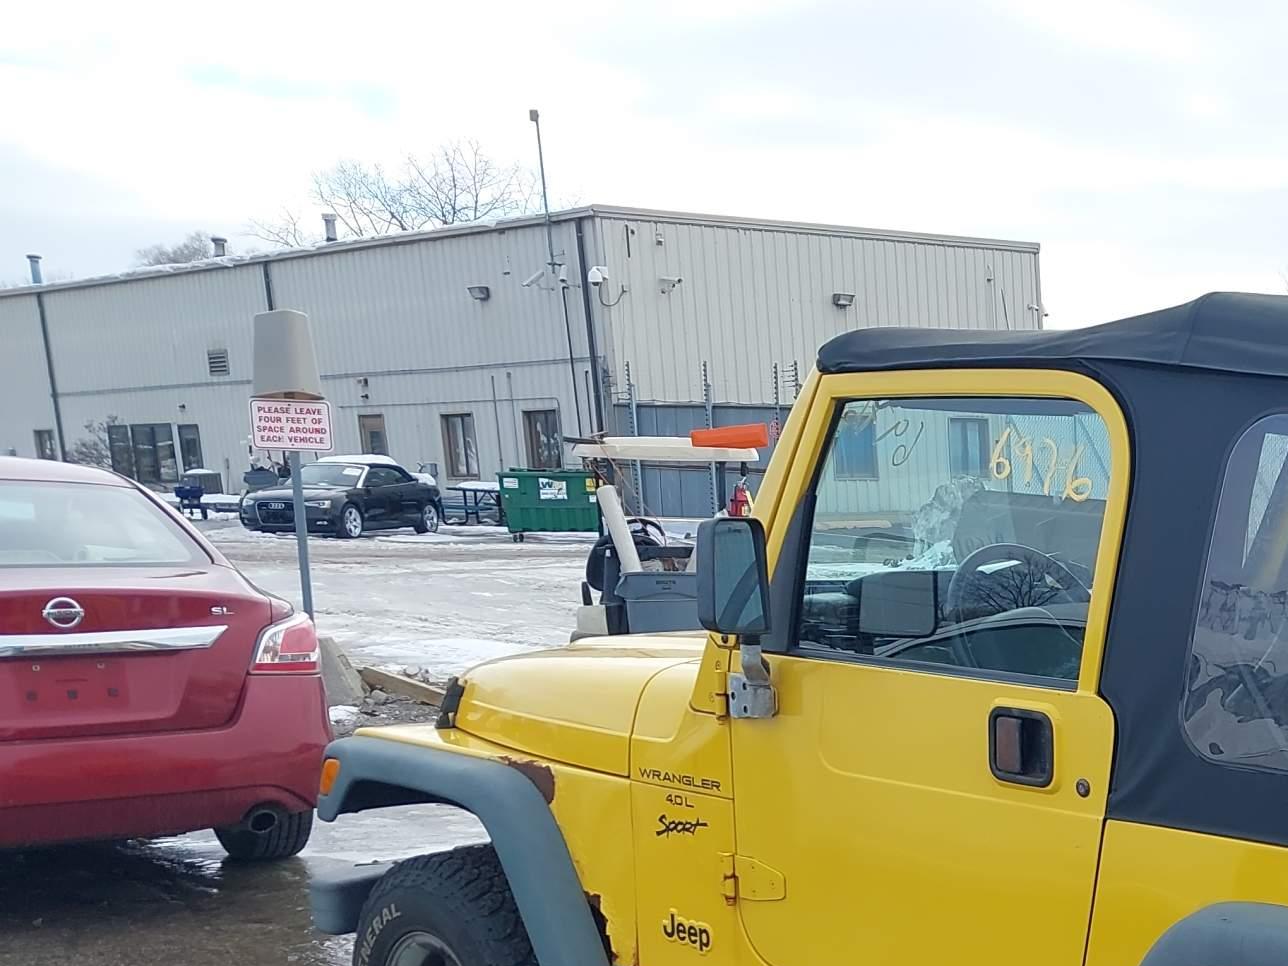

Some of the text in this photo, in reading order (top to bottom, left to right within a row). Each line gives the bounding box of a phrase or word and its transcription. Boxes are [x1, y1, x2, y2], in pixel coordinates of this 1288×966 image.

[257, 406, 322, 415] PLEASE LEAVE
[258, 415, 282, 424] FOUR
[311, 417, 323, 425] OF
[256, 425, 285, 433] SPACE
[287, 436, 325, 444] VEHICLE
[991, 426, 1094, 502] 6976
[211, 606, 234, 615] SL
[639, 767, 721, 791] WRANGLER
[662, 910, 711, 952] Jeep
